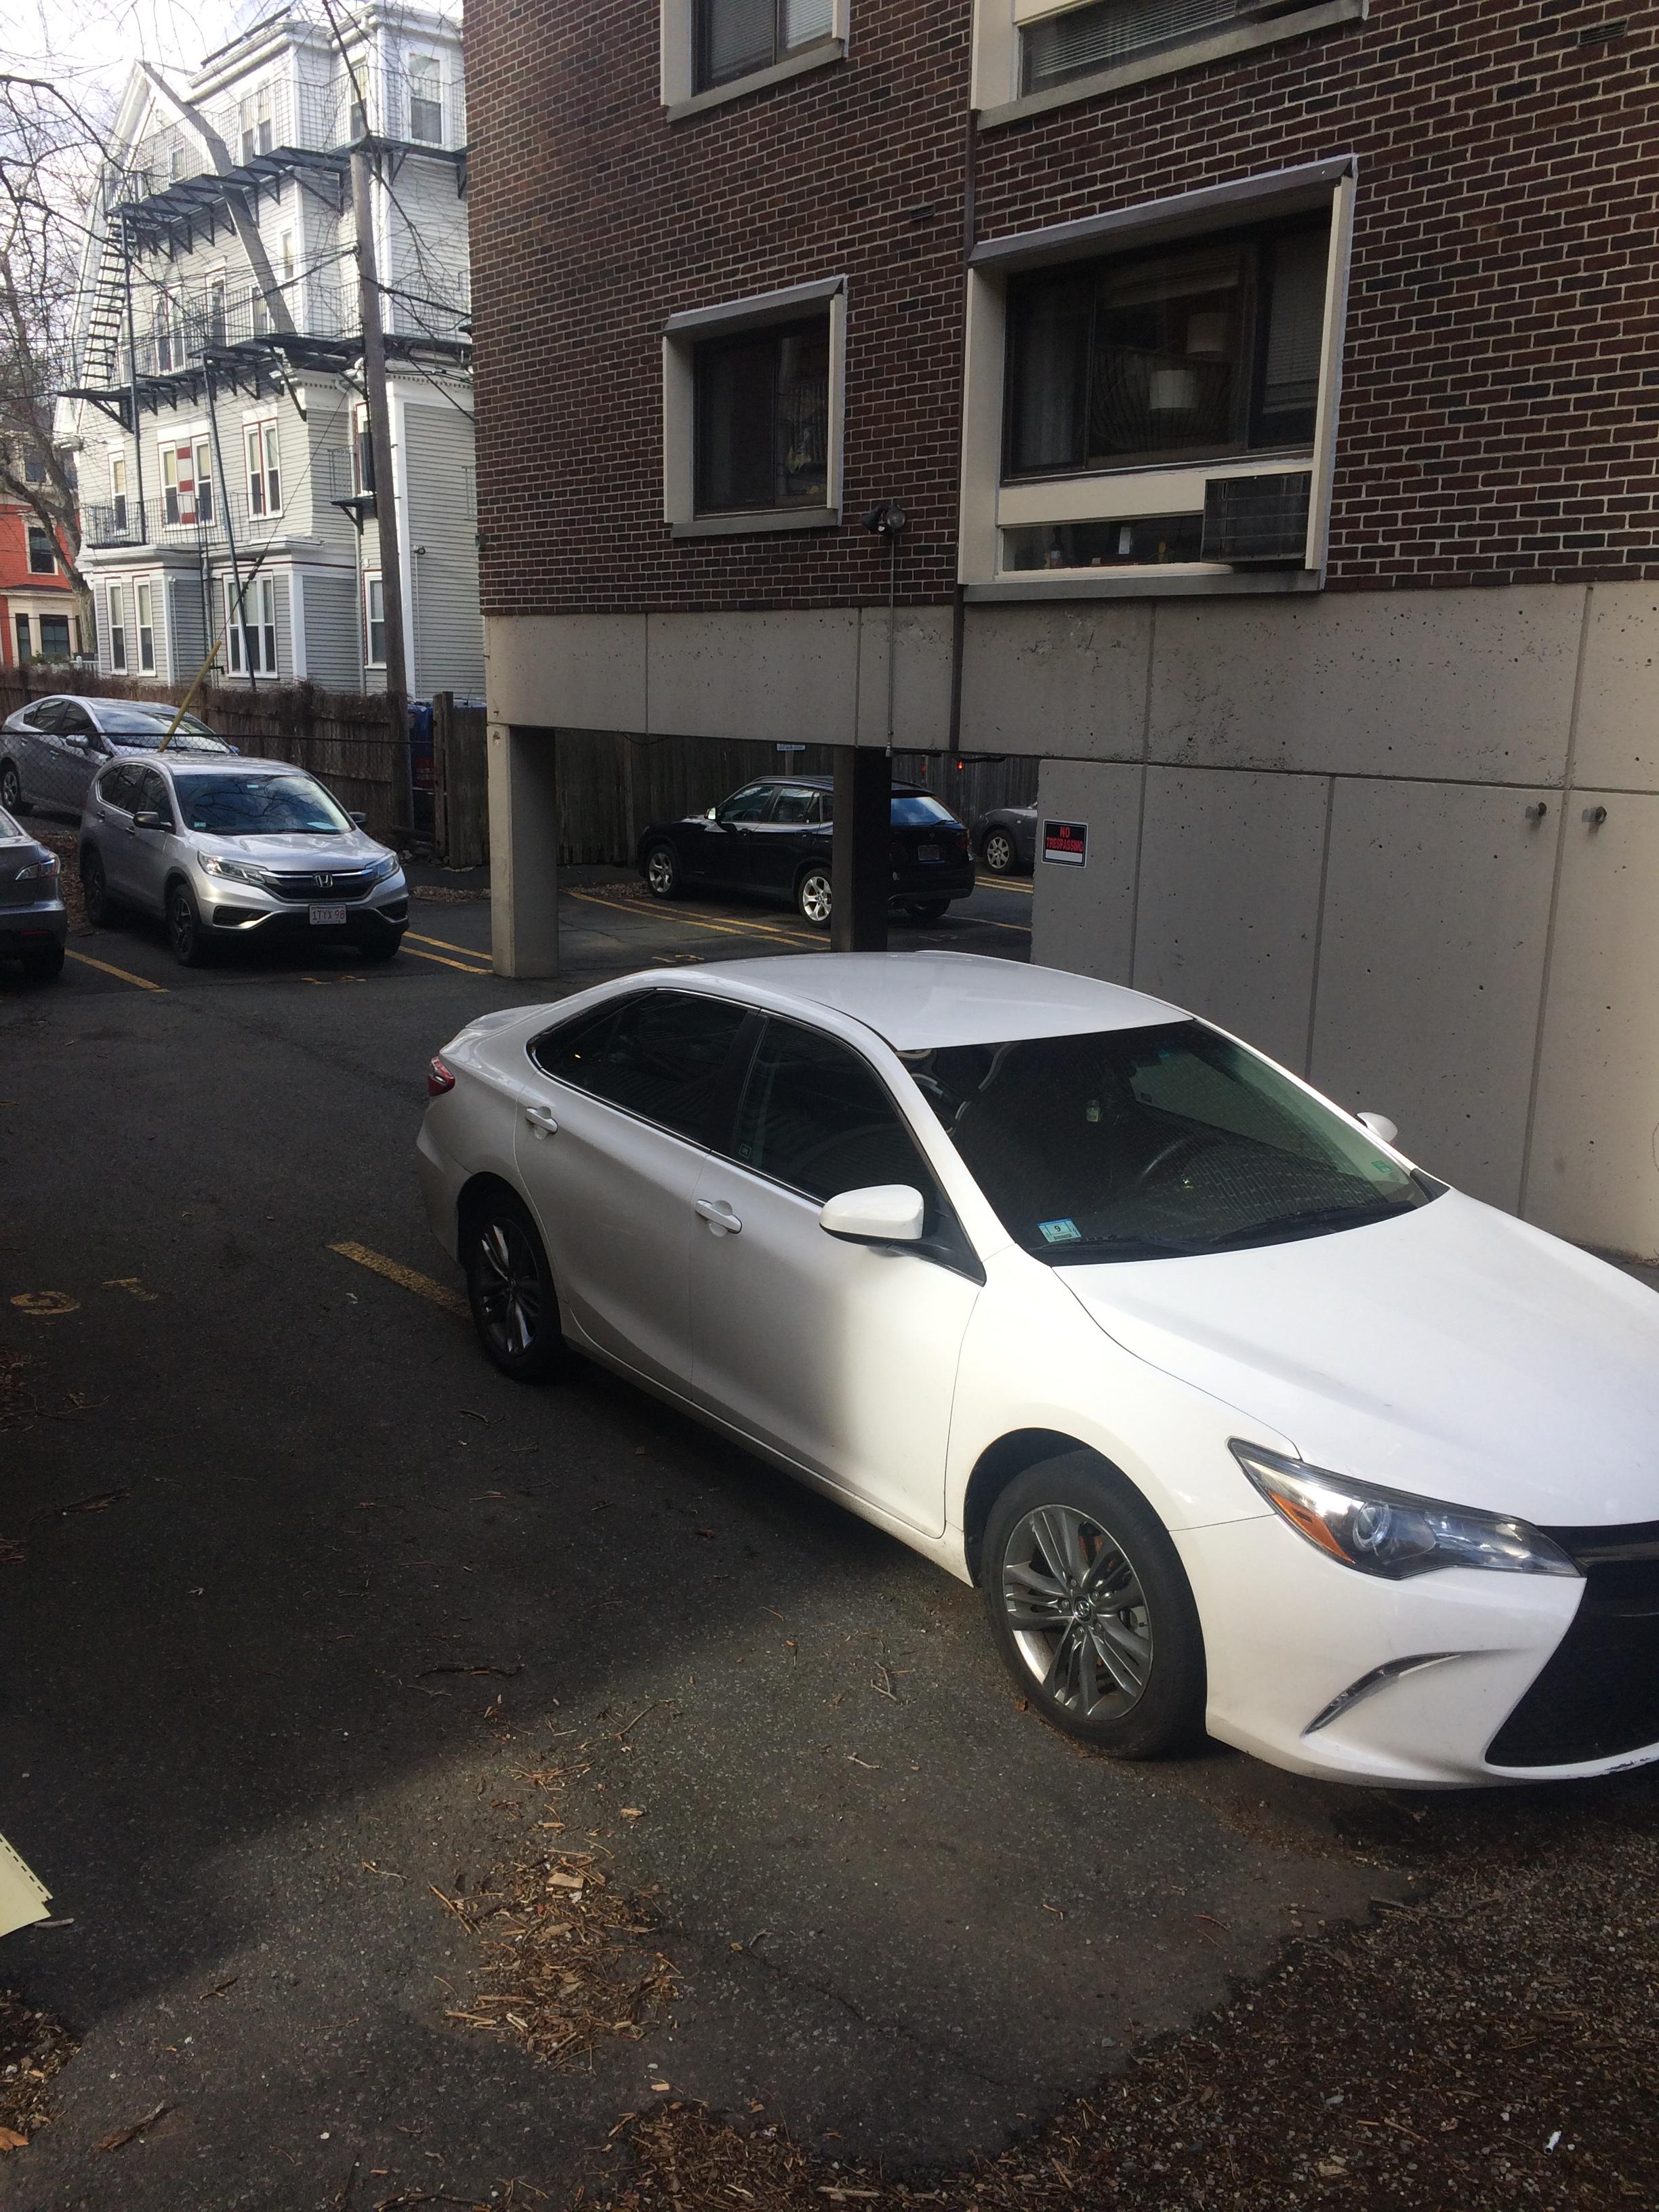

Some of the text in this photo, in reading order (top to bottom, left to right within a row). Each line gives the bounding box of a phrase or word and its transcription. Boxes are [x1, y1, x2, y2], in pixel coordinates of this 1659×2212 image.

[1059, 825, 1071, 838] NO
[1046, 837, 1084, 852] TRESPASSING
[335, 909, 345, 920] 98
